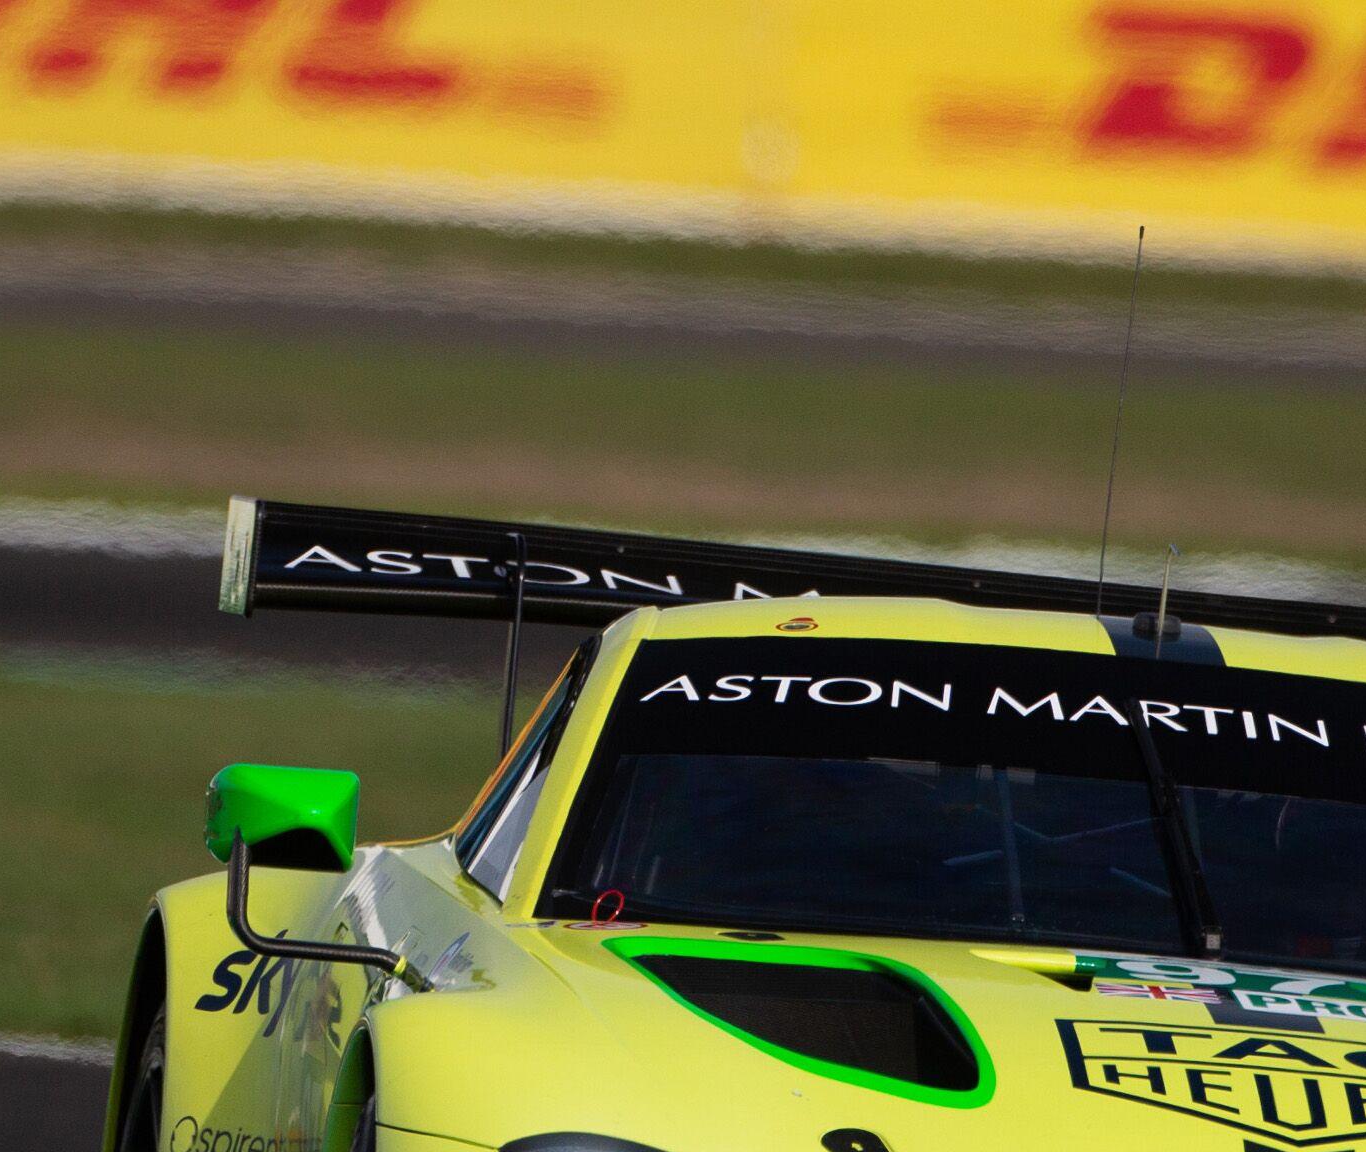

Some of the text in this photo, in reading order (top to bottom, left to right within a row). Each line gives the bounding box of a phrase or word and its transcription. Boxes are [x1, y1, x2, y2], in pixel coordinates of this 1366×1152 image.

[284, 544, 683, 597] ASTON
[639, 674, 952, 713] ASTON
[986, 686, 1331, 749] MARTIN
[1115, 960, 1347, 995] 97
